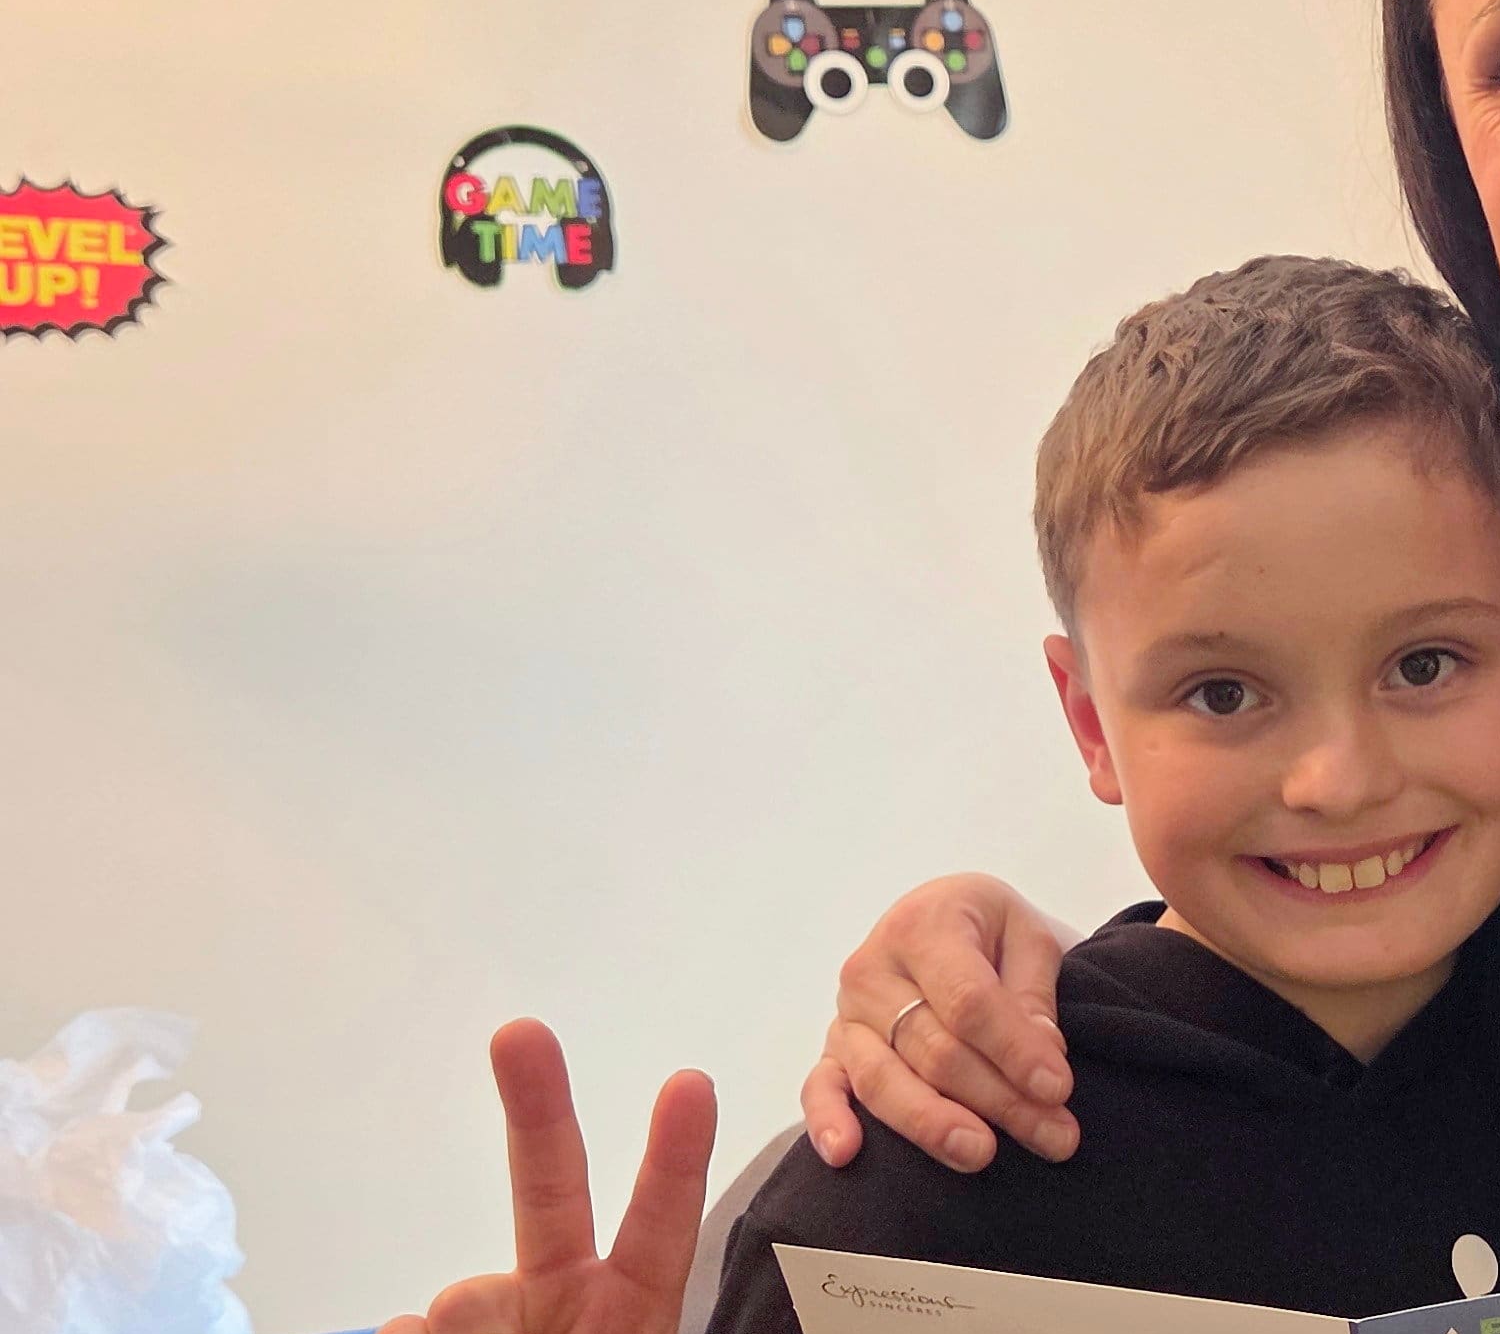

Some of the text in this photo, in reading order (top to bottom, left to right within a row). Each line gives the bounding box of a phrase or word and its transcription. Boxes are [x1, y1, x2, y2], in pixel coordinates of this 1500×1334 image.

[445, 171, 602, 219] GAME
[472, 220, 593, 265] TIME
[0, 261, 100, 310] UP!
[821, 1273, 977, 1309] Expressions
